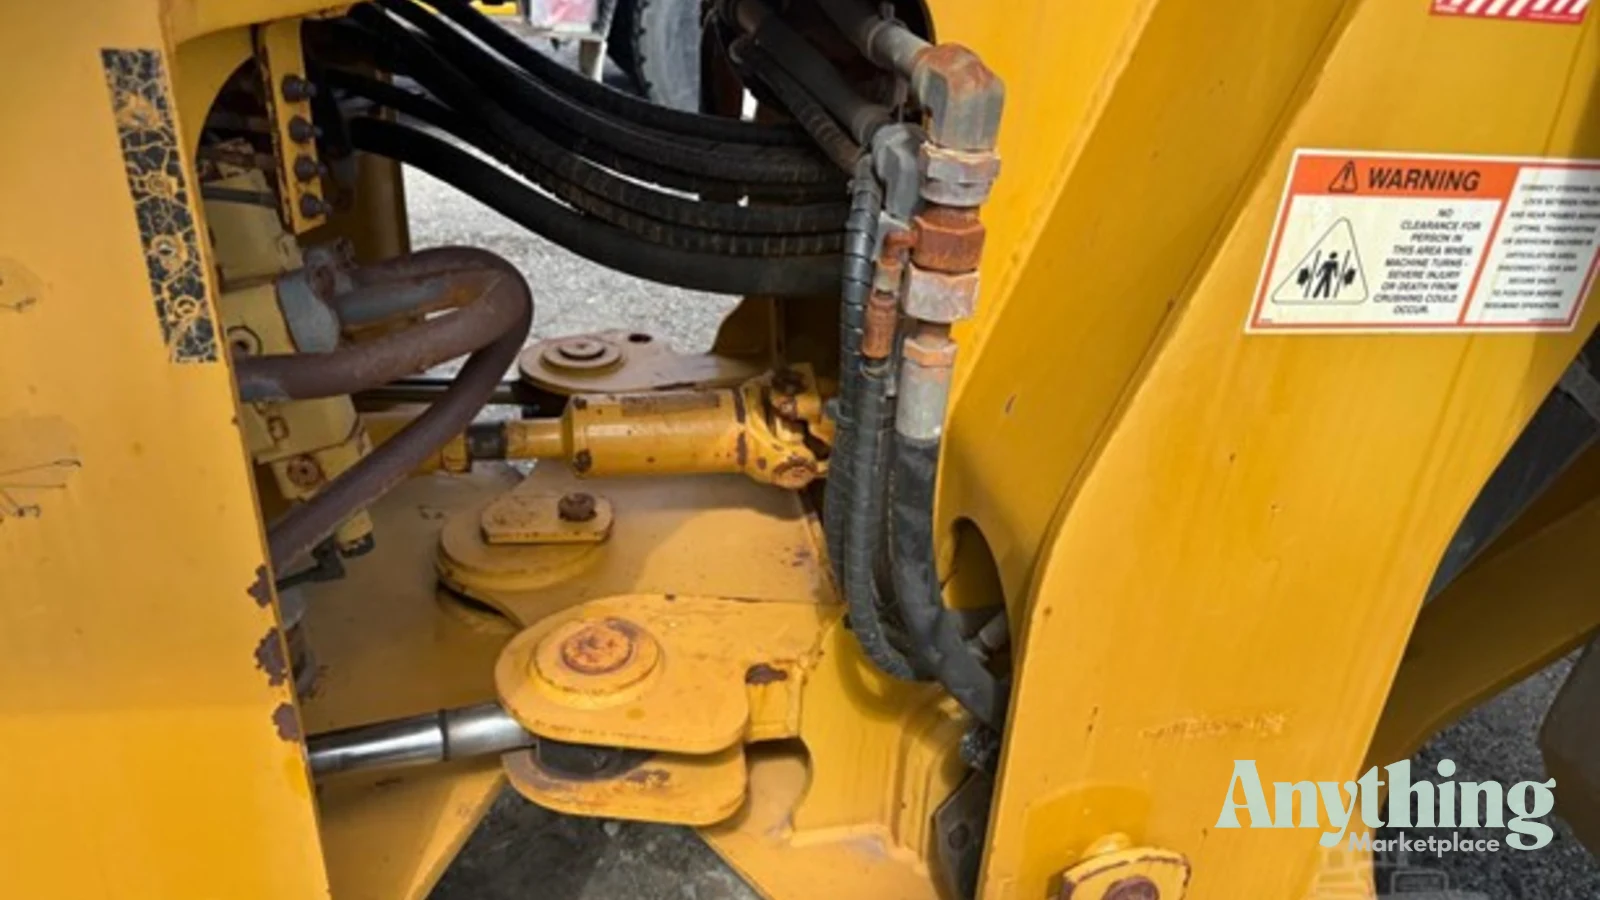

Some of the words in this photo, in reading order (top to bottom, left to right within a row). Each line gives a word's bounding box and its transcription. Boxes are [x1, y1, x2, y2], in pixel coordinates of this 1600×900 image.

[1368, 166, 1481, 192] WARNING
[1438, 208, 1454, 217] NO
[1400, 219, 1459, 230] CLEARANCE
[1460, 221, 1481, 230] FOR
[1410, 233, 1451, 242] PERSON
[1452, 234, 1464, 242] IN
[1393, 244, 1415, 254] THIS
[1416, 245, 1441, 255] AREA
[1443, 246, 1472, 255] WHEN
[1385, 258, 1429, 267] MACHINE
[1387, 270, 1424, 279] SEVERE
[1426, 270, 1461, 279] INJURY
[1381, 281, 1396, 290] OR
[1397, 281, 1429, 290] DEATH
[1430, 282, 1459, 290] FROM
[1373, 294, 1423, 303] CRUSHING
[1424, 294, 1458, 303] COULD
